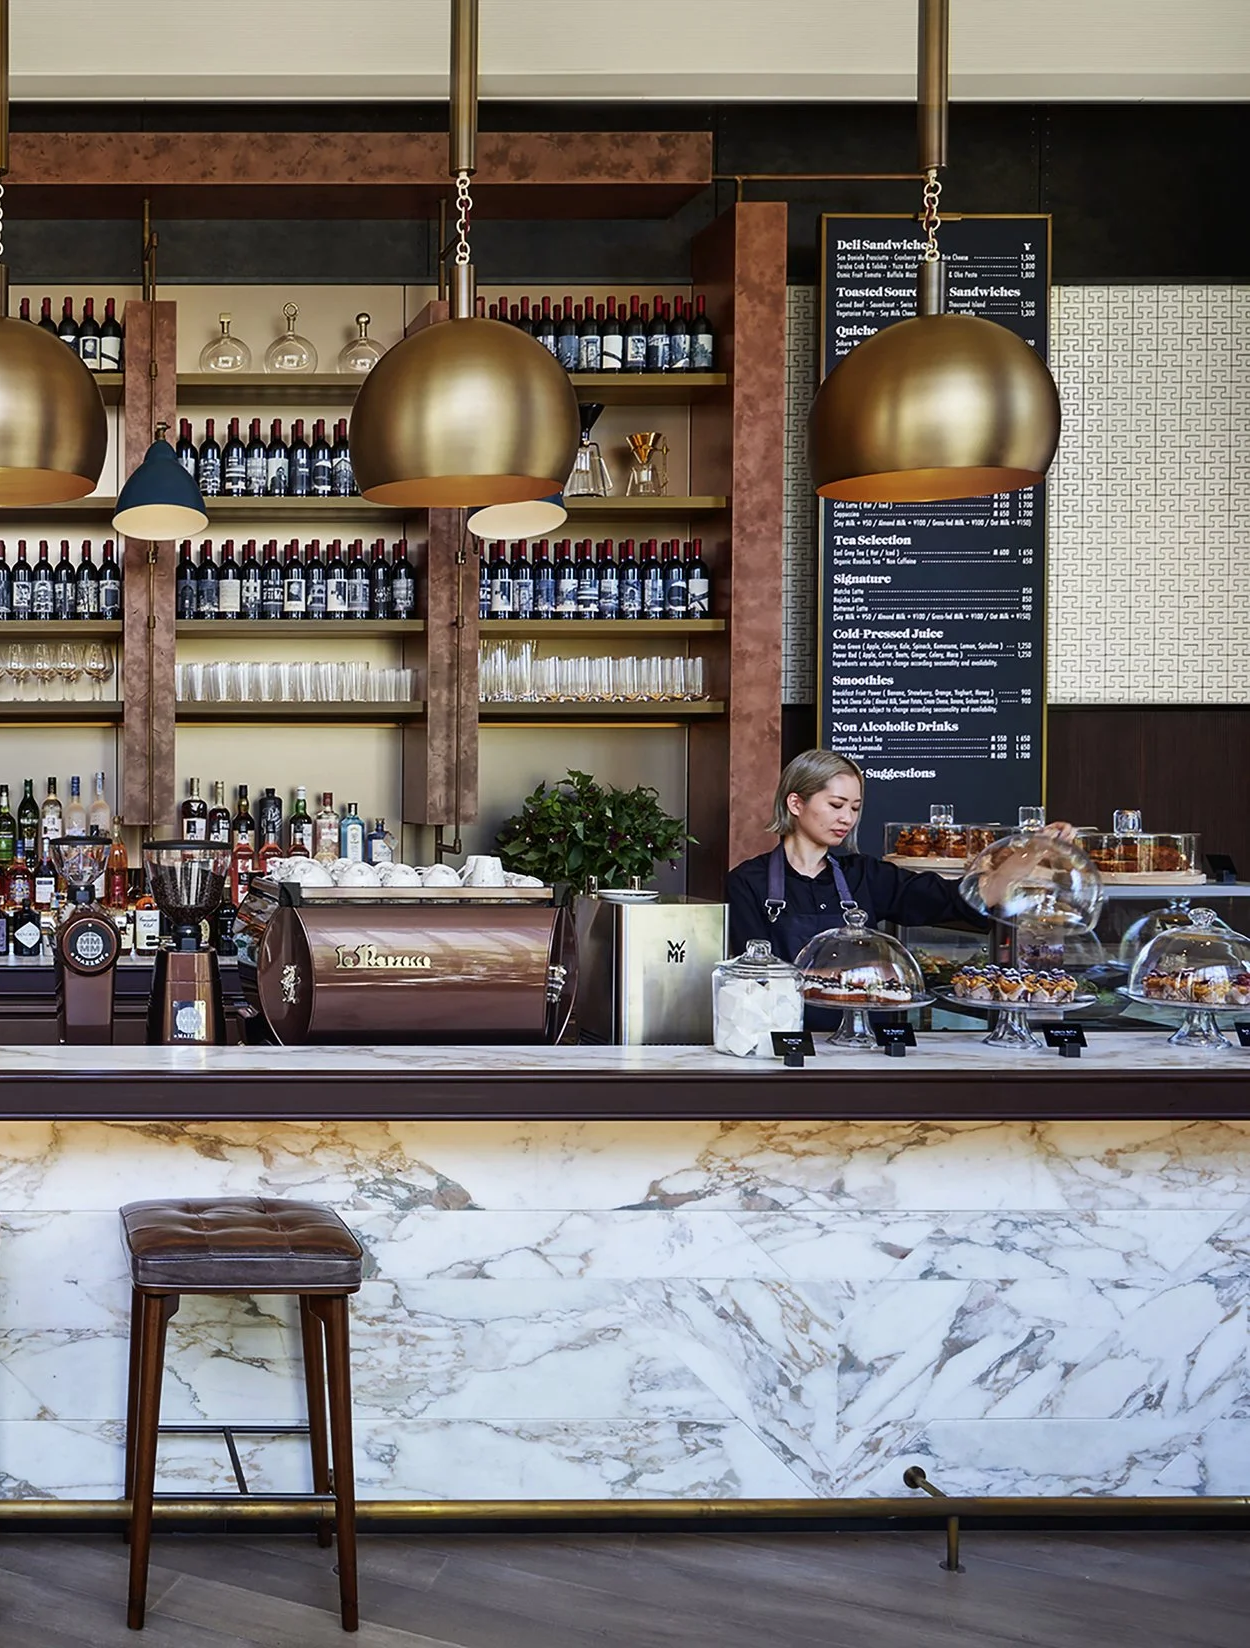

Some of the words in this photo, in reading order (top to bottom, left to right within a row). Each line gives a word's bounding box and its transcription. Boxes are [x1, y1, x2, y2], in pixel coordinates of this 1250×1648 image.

[837, 239, 861, 250] Deli
[862, 239, 933, 250] Sandwiches
[836, 286, 883, 297] Toasted
[949, 286, 1021, 297] Sandwiches
[833, 535, 856, 546] Tea
[857, 535, 912, 546] Selection
[833, 573, 892, 586] Signature
[832, 628, 910, 639] Cold-Pressed
[911, 628, 944, 639] Juice
[832, 675, 895, 686] Smoothies
[832, 721, 858, 732] Non
[859, 721, 916, 732] Alcoholic
[916, 721, 959, 732] Drinks
[865, 768, 936, 780] Suggestions
